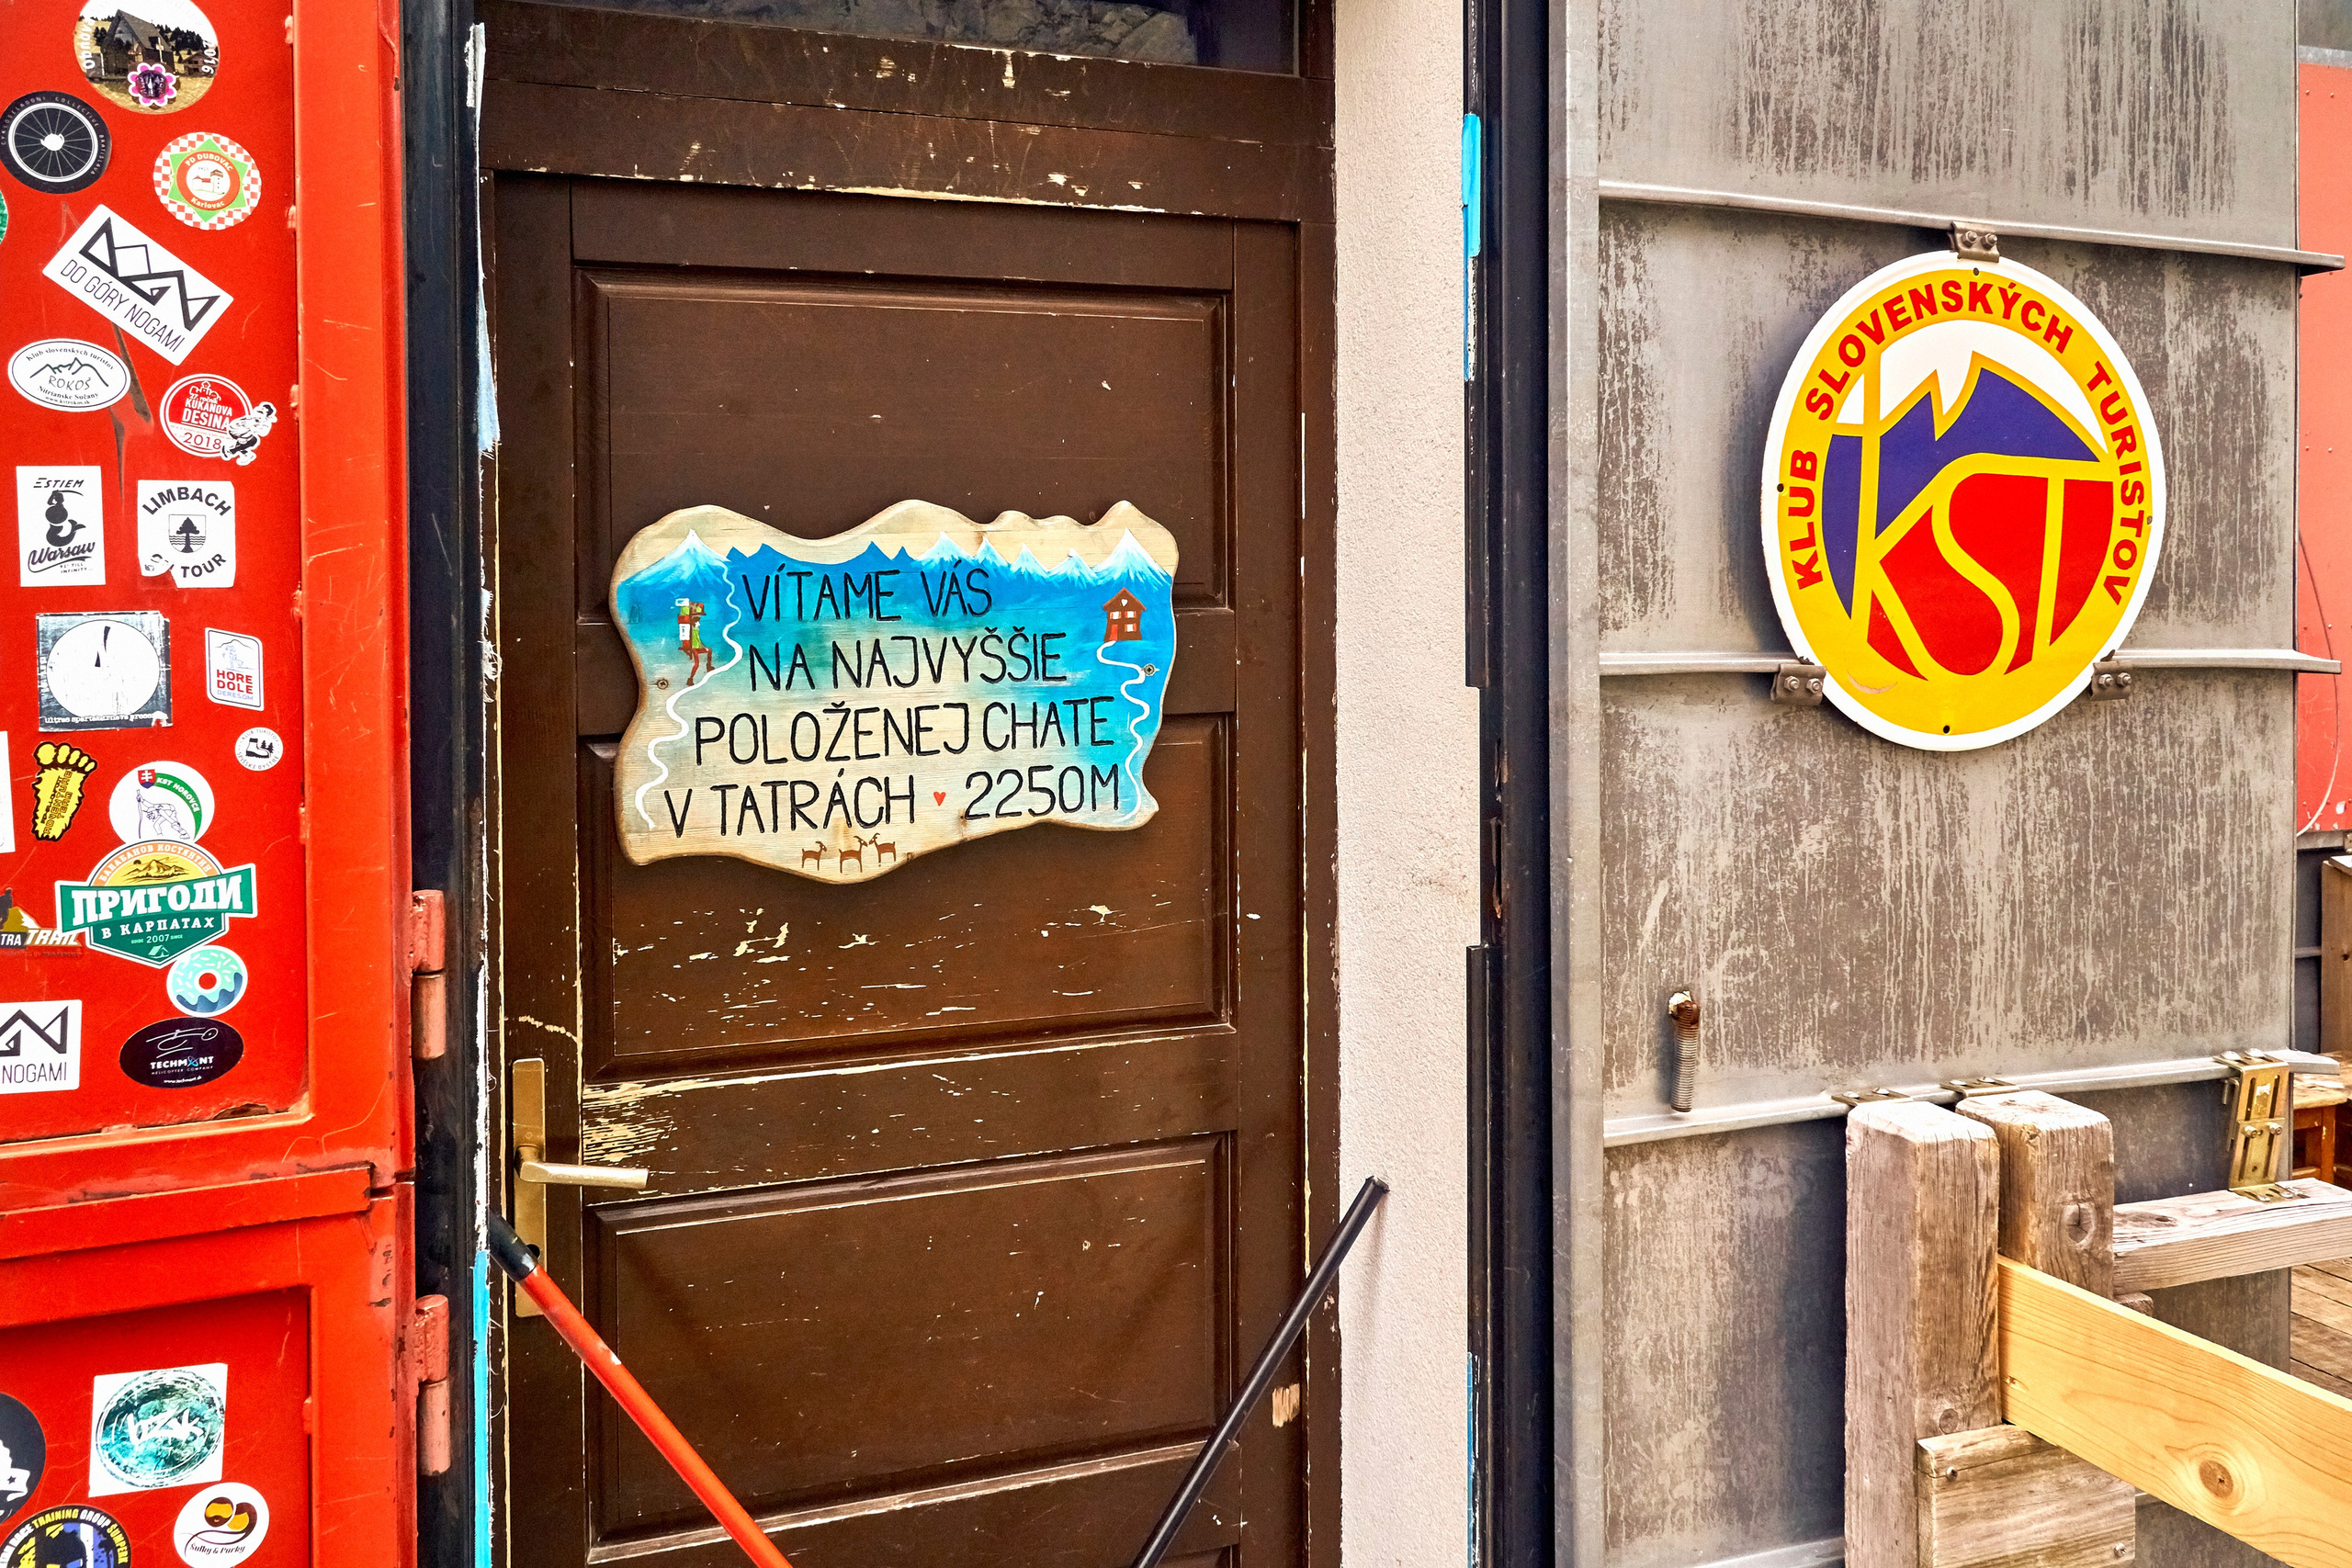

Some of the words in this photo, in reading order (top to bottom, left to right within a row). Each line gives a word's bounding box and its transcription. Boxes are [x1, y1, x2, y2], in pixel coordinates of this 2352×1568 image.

[201, 39, 219, 74] 2016
[90, 134, 107, 175] BRATISLAVA
[185, 156, 196, 166] PD
[197, 152, 233, 172] DUBOVAC
[190, 197, 225, 209] Karlovac
[60, 258, 85, 285] DO
[84, 274, 130, 311] GÓRY
[123, 303, 186, 353] NOGAMI
[26, 351, 44, 362] Klub
[38, 385, 73, 400] Nitrianske
[48, 375, 91, 391] ROKOŠ
[182, 408, 230, 430] DESINA
[184, 432, 221, 450] 2018
[1787, 448, 1825, 591] KLUB
[1806, 280, 2075, 422] SLOVENSKÝCH
[2086, 359, 2145, 606] TURISTOV
[33, 478, 85, 488] ESTIEM
[141, 486, 232, 516] LIMBACH
[28, 542, 96, 567] Warsaw
[180, 553, 227, 578] TOUR
[741, 562, 903, 622] VÍTAME
[921, 559, 993, 618] VÁS
[749, 641, 817, 692] NA
[831, 626, 1068, 690] NAJVYŠŠIE
[216, 669, 254, 684] HORE
[217, 680, 254, 694] DOLE
[695, 700, 970, 766] POLOŽENEJ
[982, 695, 1115, 752] CHATE
[56, 791, 74, 819] TEAM
[156, 777, 174, 786] KST
[172, 783, 200, 813] HOROVCE
[663, 788, 694, 839] V
[710, 768, 916, 837] TATRÁCH
[964, 763, 1120, 821] 2250M
[97, 844, 153, 883] БАЛАБАНОВ
[157, 843, 212, 874] КОСТЯНТИН
[71, 874, 243, 927] ПРИГОДИ
[26, 930, 80, 945] TRAIL
[101, 928, 112, 940] В
[119, 917, 216, 936] КАРПАТАХ
[146, 933, 170, 943] 2007
[2, 1062, 67, 1084] NOGAMI
[152, 1067, 184, 1076] HELICOPTER
[31, 1508, 79, 1529] TRAINING
[79, 1509, 111, 1529] GROUP
[107, 1523, 129, 1565] ŠUMPERK
